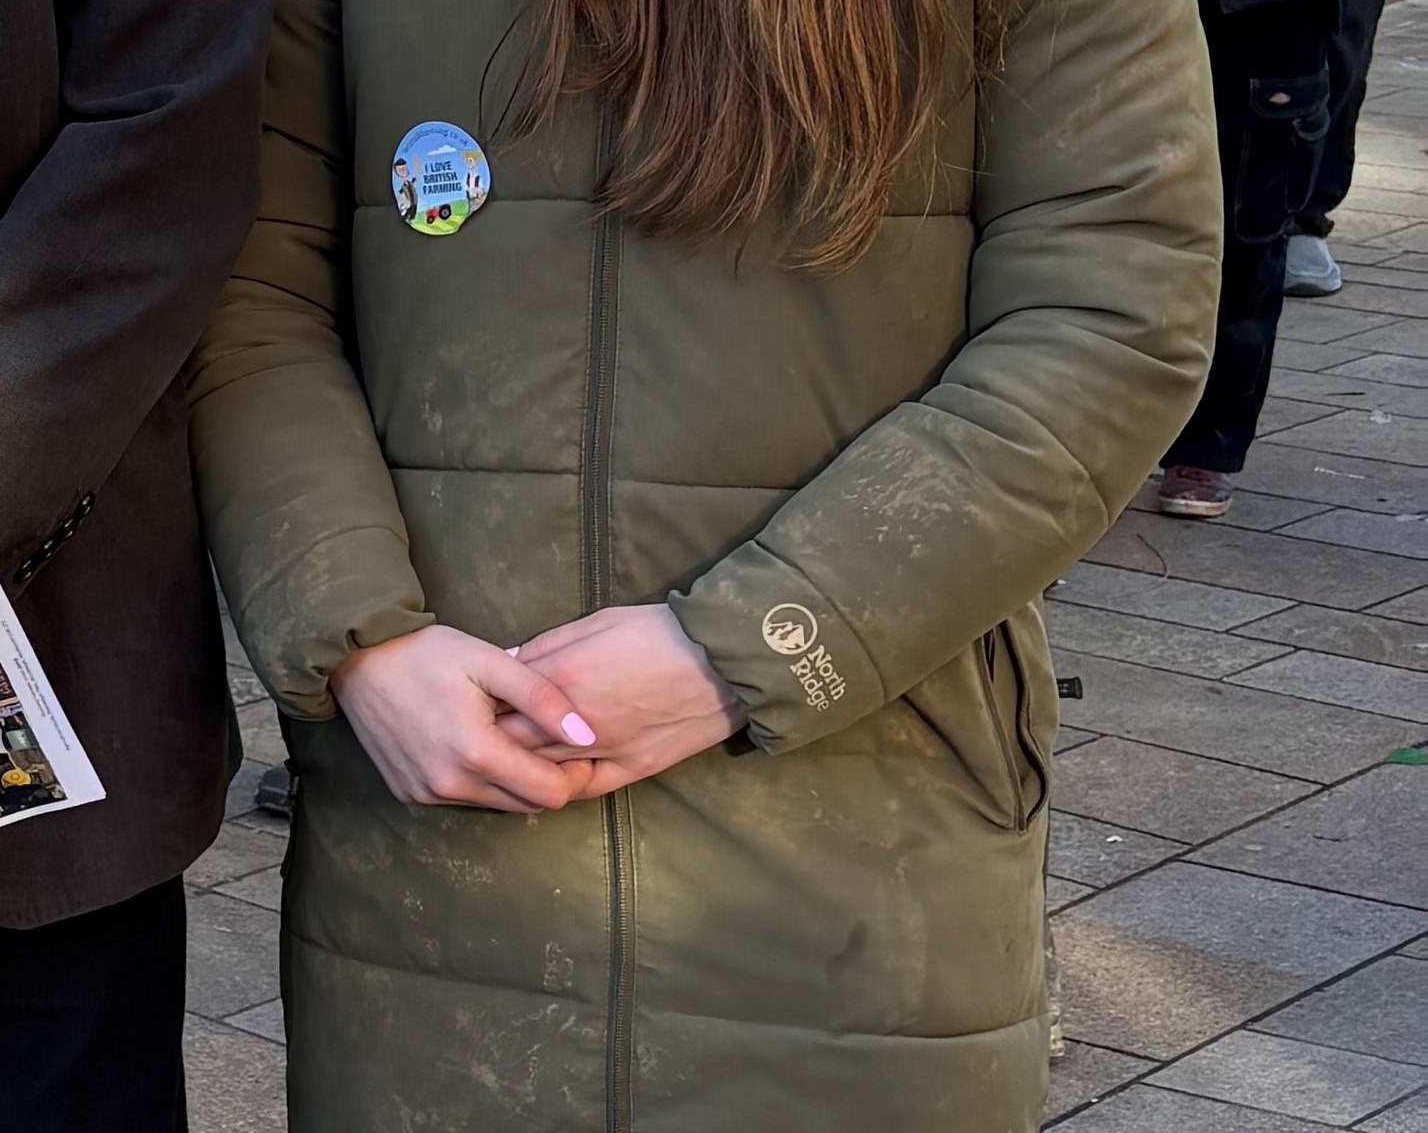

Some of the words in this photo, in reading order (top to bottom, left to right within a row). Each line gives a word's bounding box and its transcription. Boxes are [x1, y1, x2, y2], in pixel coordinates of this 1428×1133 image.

[431, 160, 453, 173] LOVE
[789, 656, 830, 712] Ridge
[807, 644, 846, 701] North
